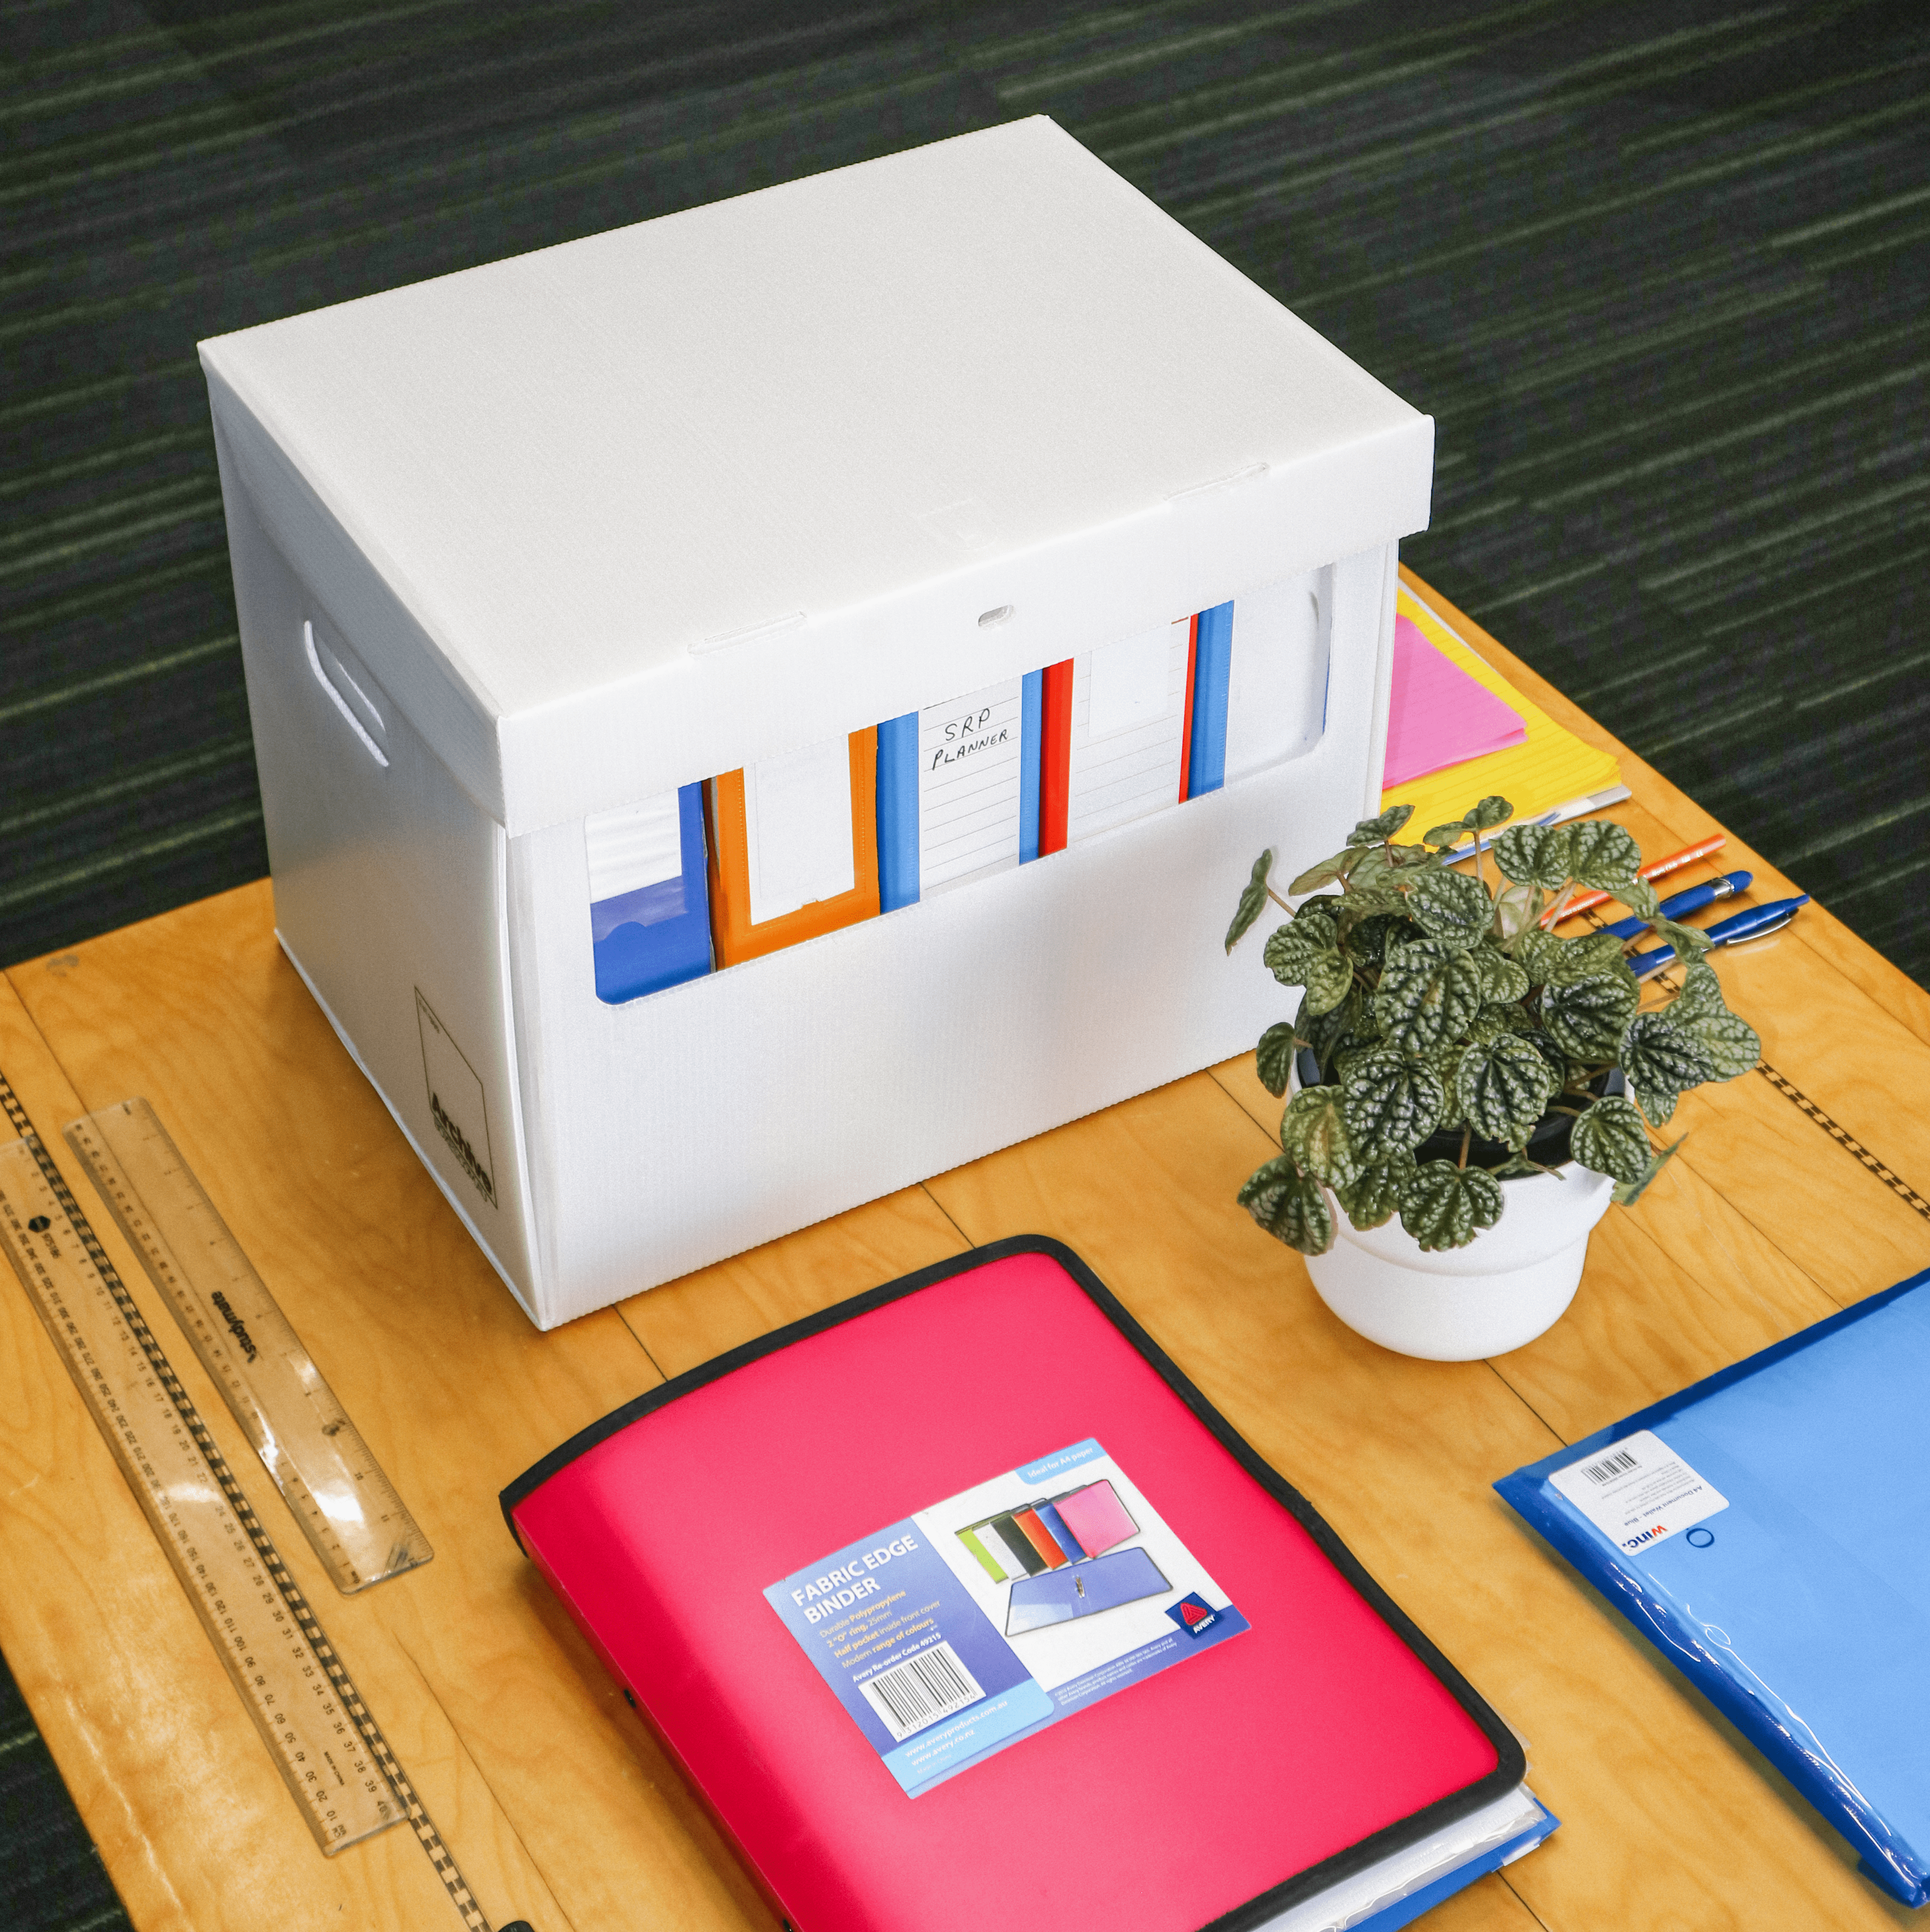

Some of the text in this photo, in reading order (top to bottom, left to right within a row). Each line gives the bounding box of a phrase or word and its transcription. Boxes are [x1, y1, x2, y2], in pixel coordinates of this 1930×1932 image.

[944, 707, 990, 741] SRP
[931, 729, 1008, 771] PLANNER
[432, 1092, 492, 1194] Archive
[211, 1291, 256, 1354] studymate
[1027, 1465, 1048, 1477] Ideal
[1060, 1456, 1071, 1464] A4
[1071, 1448, 1092, 1461] paper
[150, 1478, 164, 1490] 90
[1661, 1490, 1694, 1507] Document
[380, 1514, 390, 1523] 11
[1642, 1505, 1663, 1517] Wallet
[1624, 1517, 1640, 1526] Blue
[177, 1529, 190, 1544] 160
[1621, 1525, 1668, 1548] winc.
[186, 1546, 200, 1562] 150
[195, 1563, 208, 1579] 140
[790, 1533, 918, 1606] FABRIC EDGE
[205, 1581, 218, 1597] 130
[214, 1599, 227, 1615] 120
[803, 1577, 881, 1624] BINDER
[818, 1590, 906, 1638] Durable Polypropylene
[223, 1617, 237, 1633] 110
[833, 1600, 940, 1658] Half pocket inside front cover
[848, 1624, 868, 1636] ring,
[867, 1610, 892, 1627] 25mm
[1193, 1614, 1215, 1634] AVERY
[214, 1505, 226, 1517] 24
[223, 1522, 236, 1535] 25
[233, 1539, 246, 1552] 26
[242, 1556, 255, 1569] 27
[251, 1573, 264, 1587] 28
[262, 1591, 275, 1604] 29
[272, 1609, 285, 1622] 30
[281, 1627, 294, 1640] 31
[291, 1646, 304, 1659] 32
[302, 1665, 315, 1678] 33
[312, 1683, 325, 1697] 34
[322, 1701, 335, 1715] 35
[332, 1721, 345, 1735] 36
[343, 1740, 357, 1753] 37
[353, 1759, 366, 1773] 38
[364, 1779, 377, 1793] 39
[234, 1635, 247, 1652] 100
[841, 1617, 934, 1669] Modern range of colours
[244, 1656, 256, 1668] 90
[853, 1632, 941, 1683] Avery Re-order Code 49215
[254, 1674, 266, 1687] 80
[263, 1693, 276, 1706] 70
[274, 1712, 286, 1725] 60
[905, 1700, 1007, 1757] www.averyproducts.com.au
[284, 1731, 296, 1744] 50
[911, 1729, 975, 1766] www.avery.co.nz
[294, 1751, 306, 1762] 40
[304, 1770, 317, 1783] 30
[315, 1788, 328, 1803] 20
[326, 1809, 338, 1822] 10
